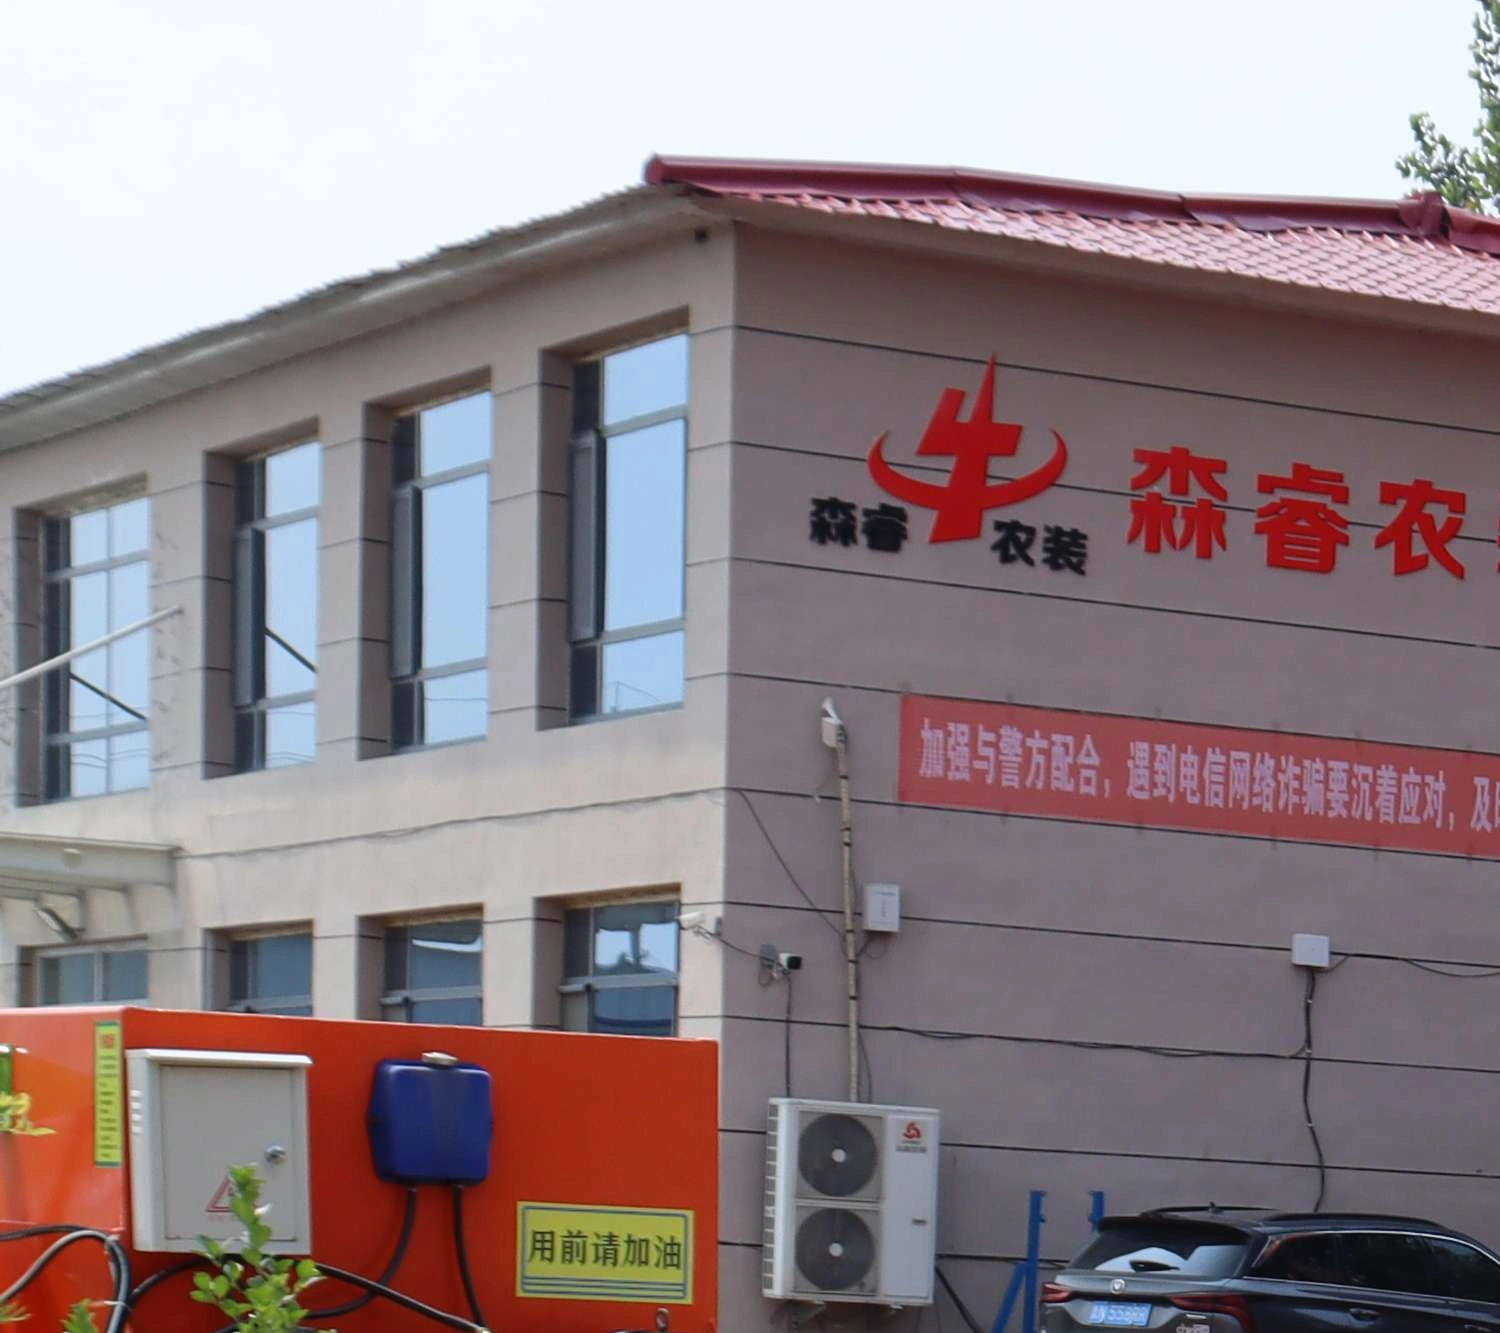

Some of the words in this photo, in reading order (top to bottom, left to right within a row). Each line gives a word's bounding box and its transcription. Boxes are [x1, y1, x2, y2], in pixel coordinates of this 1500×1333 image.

[809, 497, 909, 553] 森睿
[991, 519, 1089, 576] 农装
[528, 1229, 683, 1271] 用前请加油
